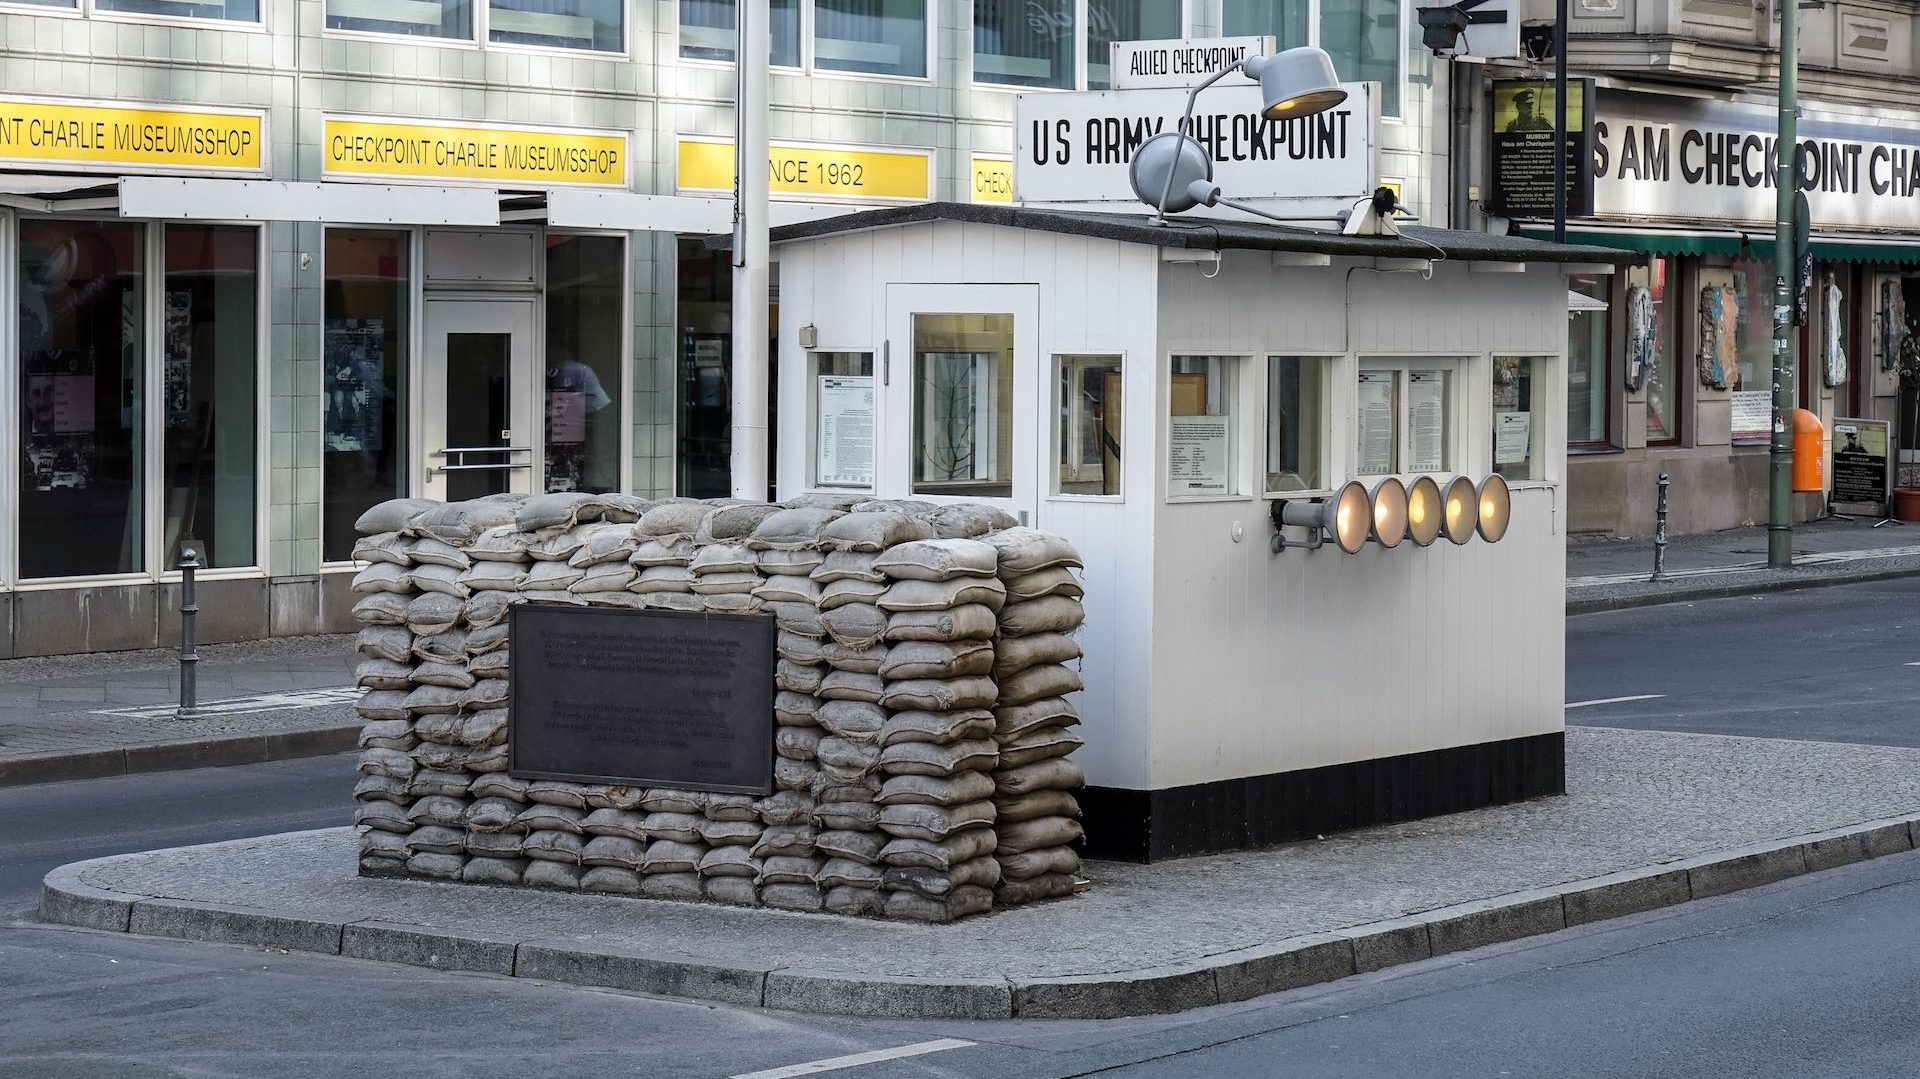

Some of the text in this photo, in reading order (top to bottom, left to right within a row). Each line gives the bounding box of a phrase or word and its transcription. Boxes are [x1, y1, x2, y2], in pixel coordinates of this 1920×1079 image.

[1131, 46, 1246, 76] ALLIED CHECKPOINT
[29, 119, 105, 149] CHARLIE
[114, 123, 252, 157] MUSEUMSSHOP
[332, 135, 617, 174] CHECKPOINT CHARLIE MUSEUMSSHOP
[1033, 118, 1071, 166] US
[817, 163, 863, 186] 1962
[1617, 125, 1670, 182] AM
[1680, 129, 1862, 194] CHECKOINT
